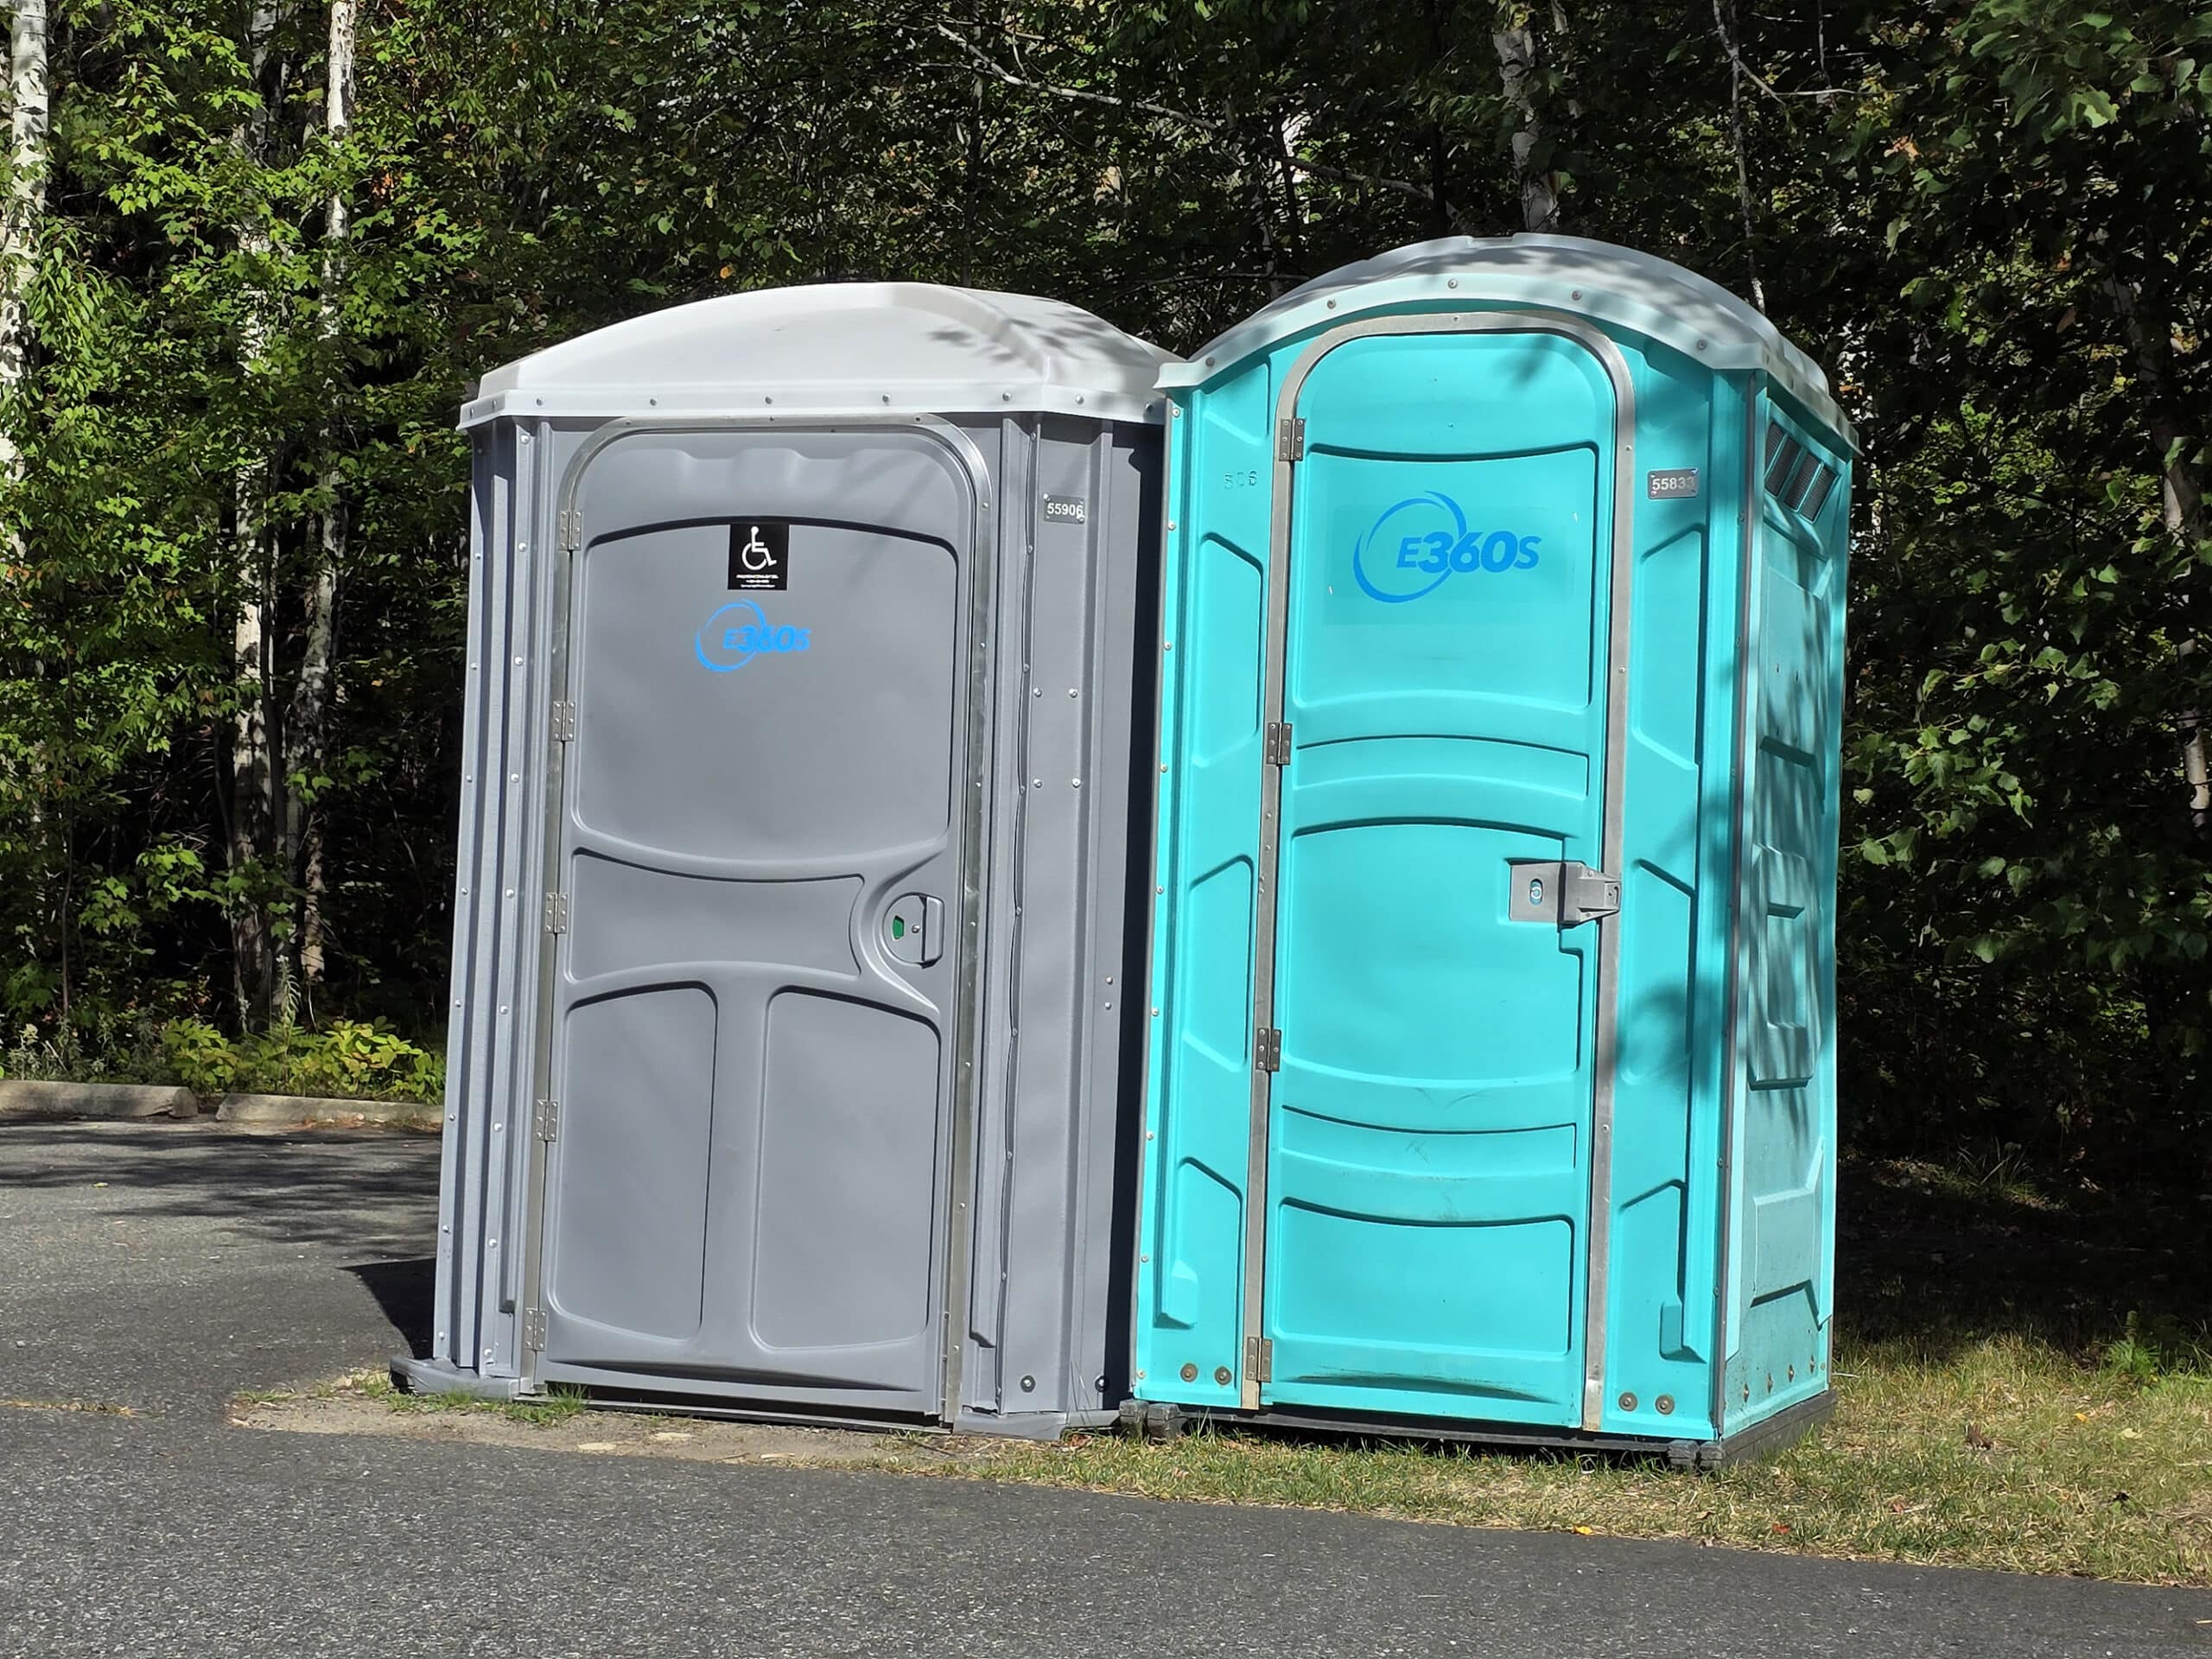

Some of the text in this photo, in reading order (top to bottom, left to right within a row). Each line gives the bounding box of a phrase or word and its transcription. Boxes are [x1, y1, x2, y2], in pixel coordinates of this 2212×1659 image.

[1046, 503, 1084, 516] 55906
[1396, 530, 1541, 572] E360S
[723, 625, 810, 652] E360S
